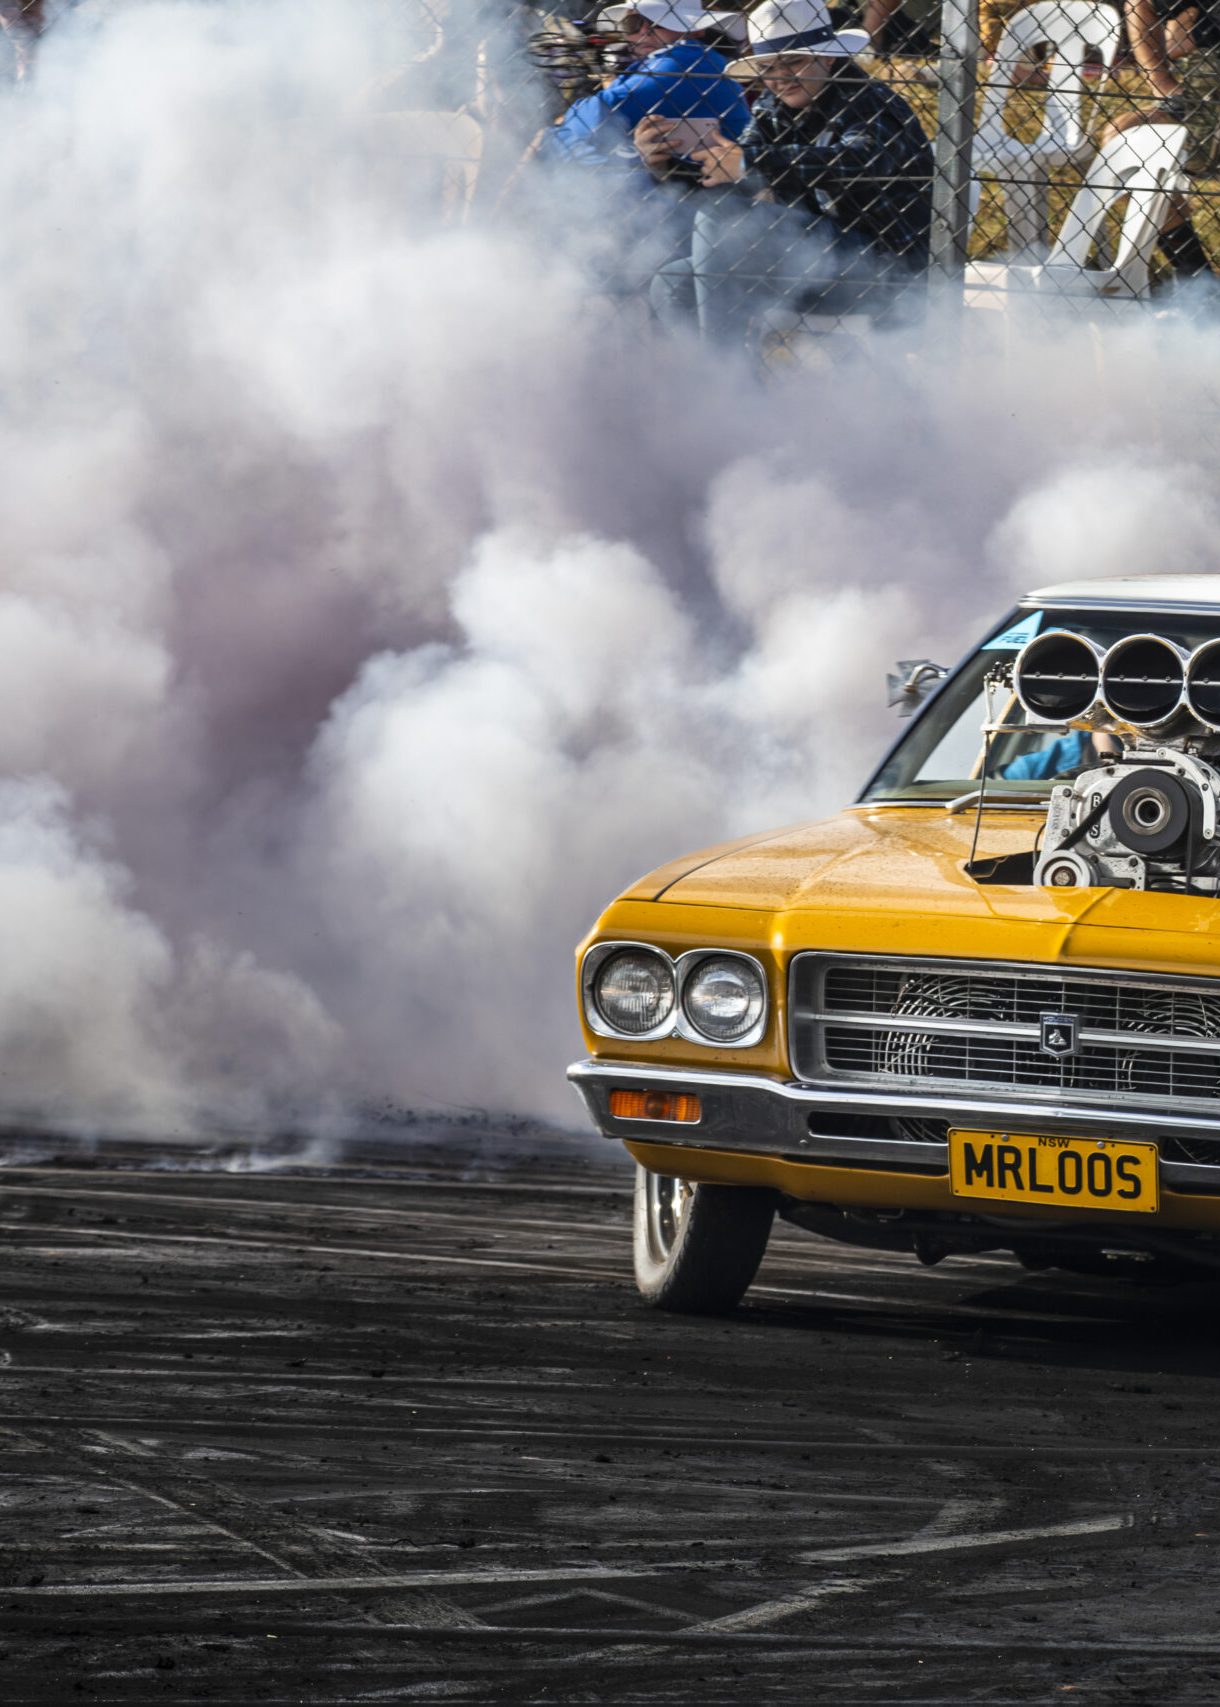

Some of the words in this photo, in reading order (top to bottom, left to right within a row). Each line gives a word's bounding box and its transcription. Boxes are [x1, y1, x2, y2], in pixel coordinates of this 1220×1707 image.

[1090, 795, 1101, 837] BS
[1037, 1136, 1070, 1148] NSW
[963, 1142, 1142, 1199] MRLOOS
